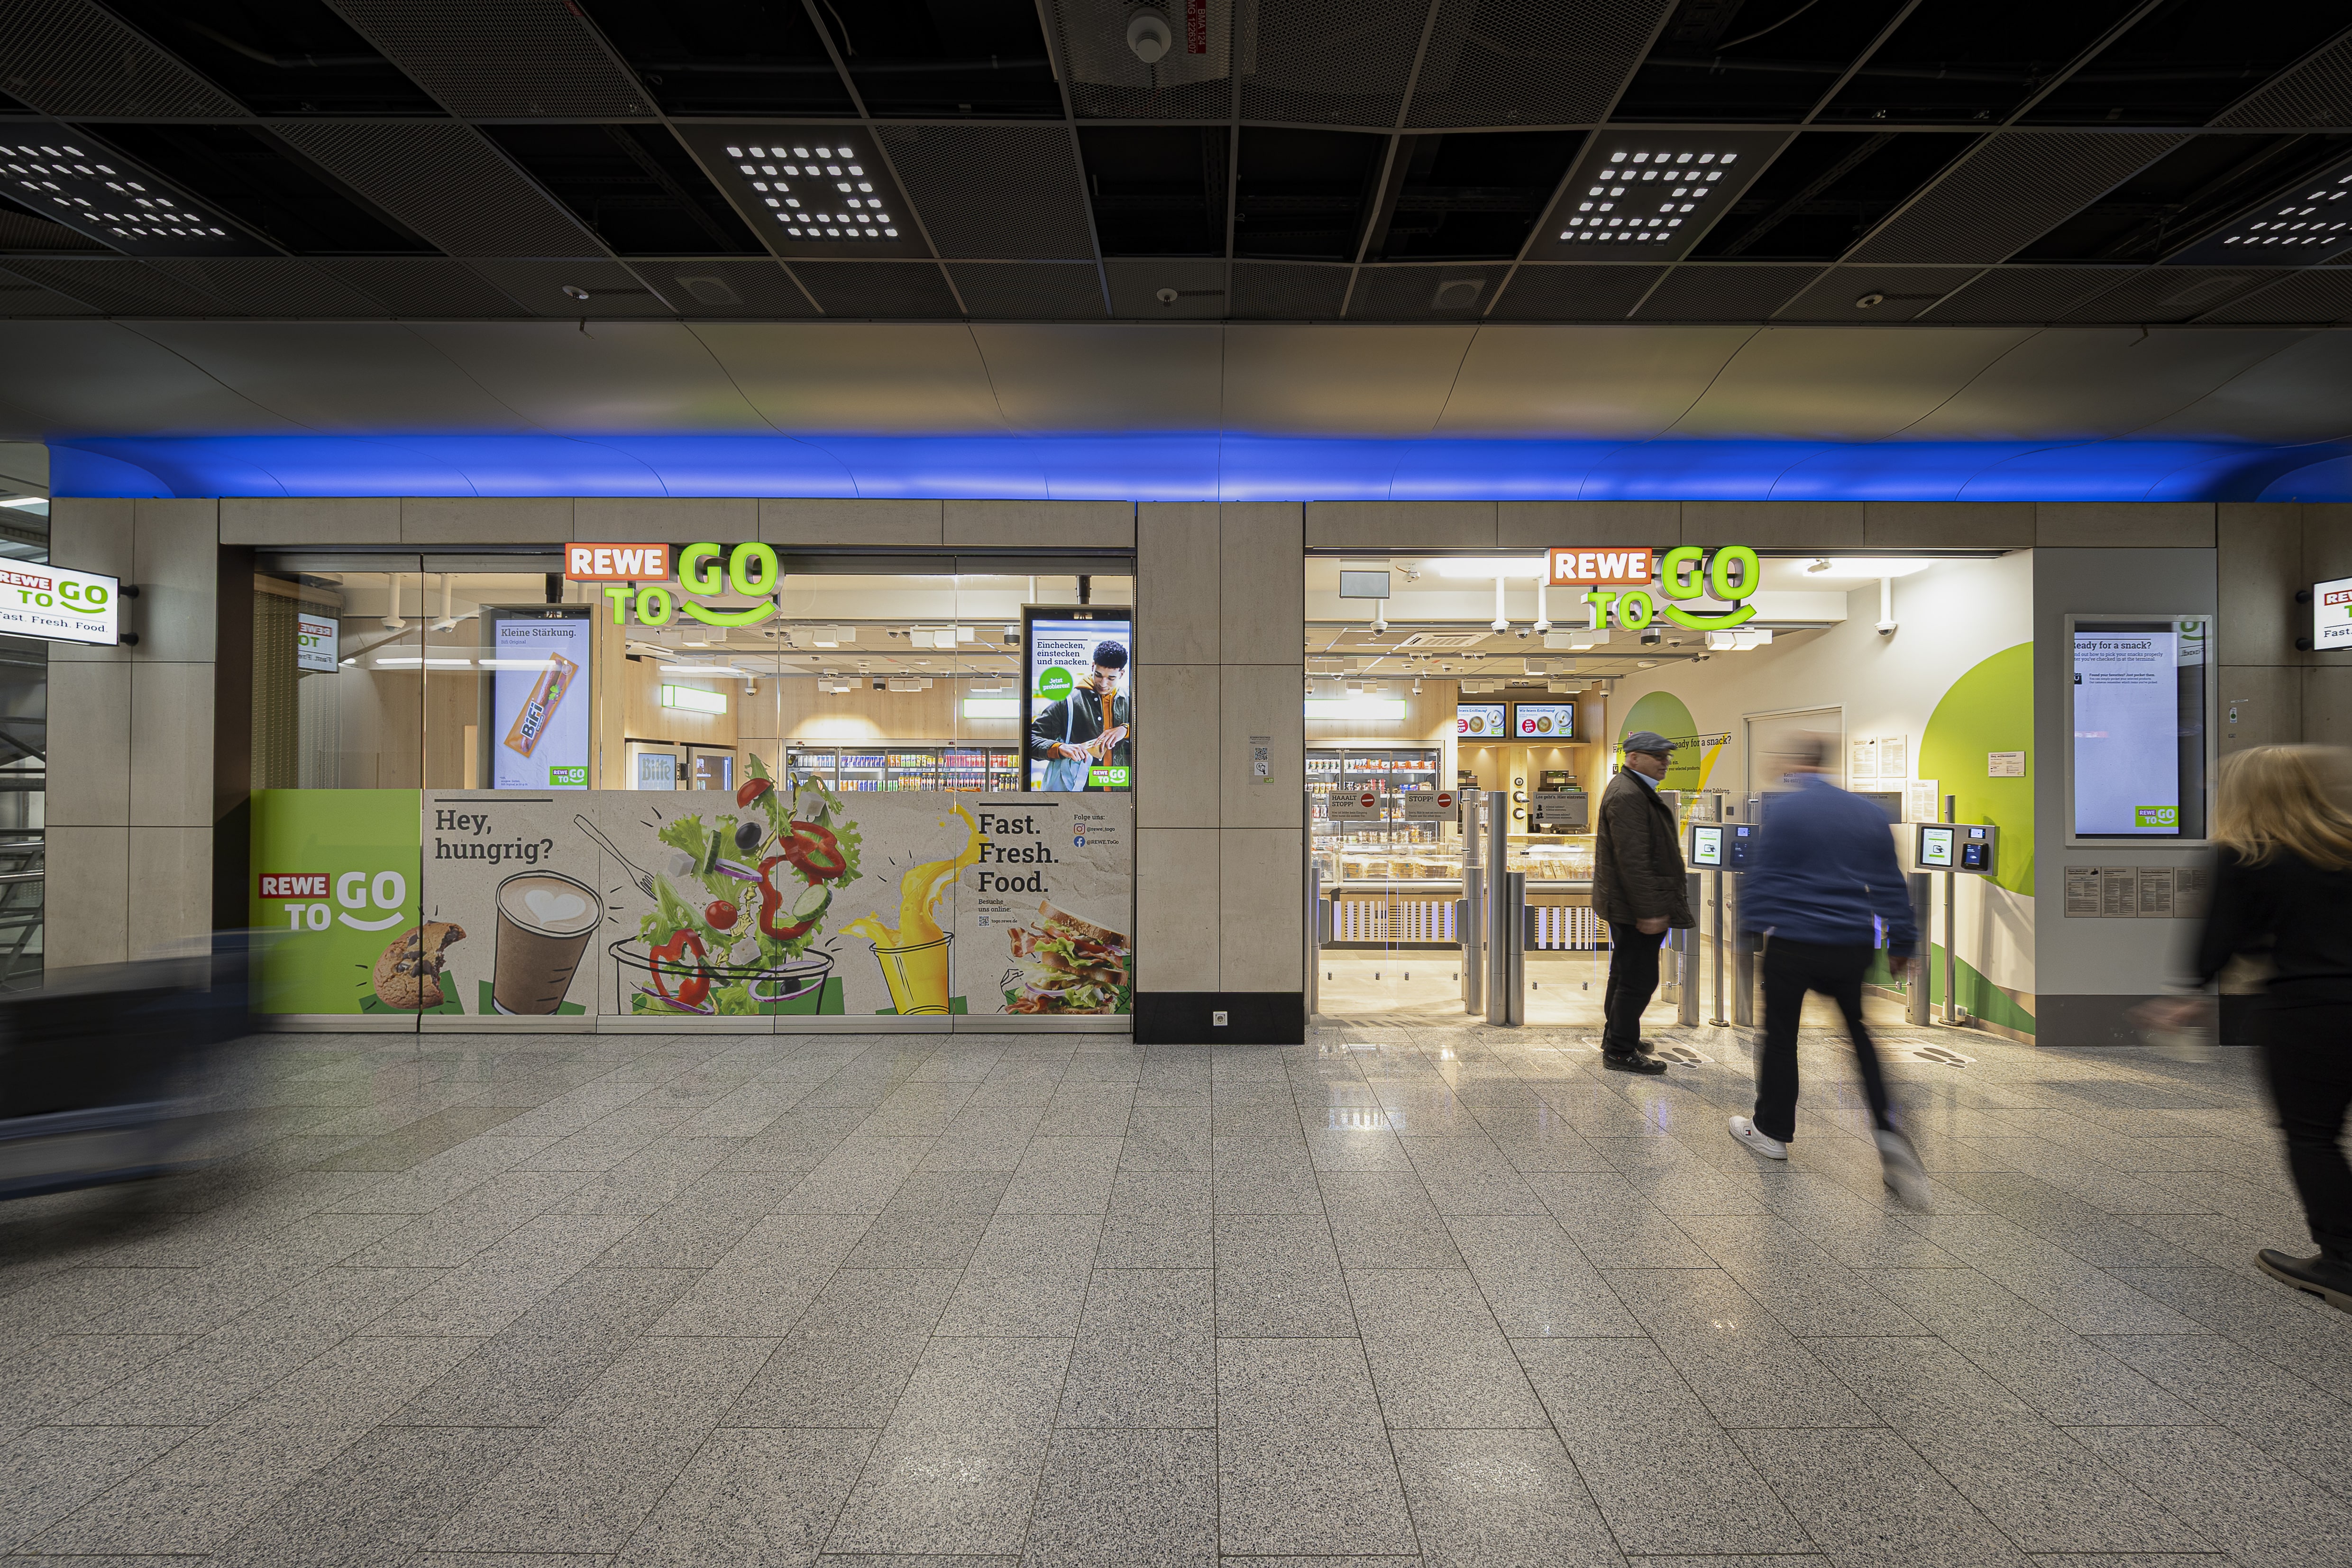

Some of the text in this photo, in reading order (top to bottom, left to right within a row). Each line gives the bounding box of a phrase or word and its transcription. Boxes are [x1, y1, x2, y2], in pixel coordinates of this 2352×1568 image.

[1188, 17, 1196, 54] 12263/07
[1198, 9, 1206, 45] BMA 124
[571, 548, 663, 575] REWE
[678, 542, 778, 596] GO
[1555, 552, 1647, 579] REWE
[0, 572, 50, 590] REWE
[1661, 545, 1760, 600] GO
[17, 589, 53, 607] TO
[58, 581, 108, 605] GO
[604, 587, 672, 626] TO
[1587, 591, 1653, 630] TO
[0, 612, 108, 633] ast. Fresh. Food.
[501, 628, 576, 638] Kleine Stärkung.
[1037, 642, 1085, 650] Einchecken,
[2099, 641, 2112, 649] for
[2121, 641, 2151, 649] snack?
[1043, 682, 1071, 691] probieren!
[521, 702, 543, 739] BiFi
[1613, 746, 1622, 754] Hey
[1691, 739, 1700, 747] for
[1707, 735, 1731, 746] snack?
[569, 769, 585, 778] GO
[642, 758, 671, 780] Bitte
[1110, 769, 1126, 779] GO
[435, 809, 492, 835] Hey,
[979, 814, 1041, 834] Fast.
[2158, 809, 2175, 818] GO
[435, 838, 553, 864] hungrig?
[979, 842, 1059, 863] Fresh.
[263, 877, 326, 896] REWE
[337, 871, 406, 909] GO
[978, 871, 1049, 892] Food.
[285, 903, 331, 931] TO
